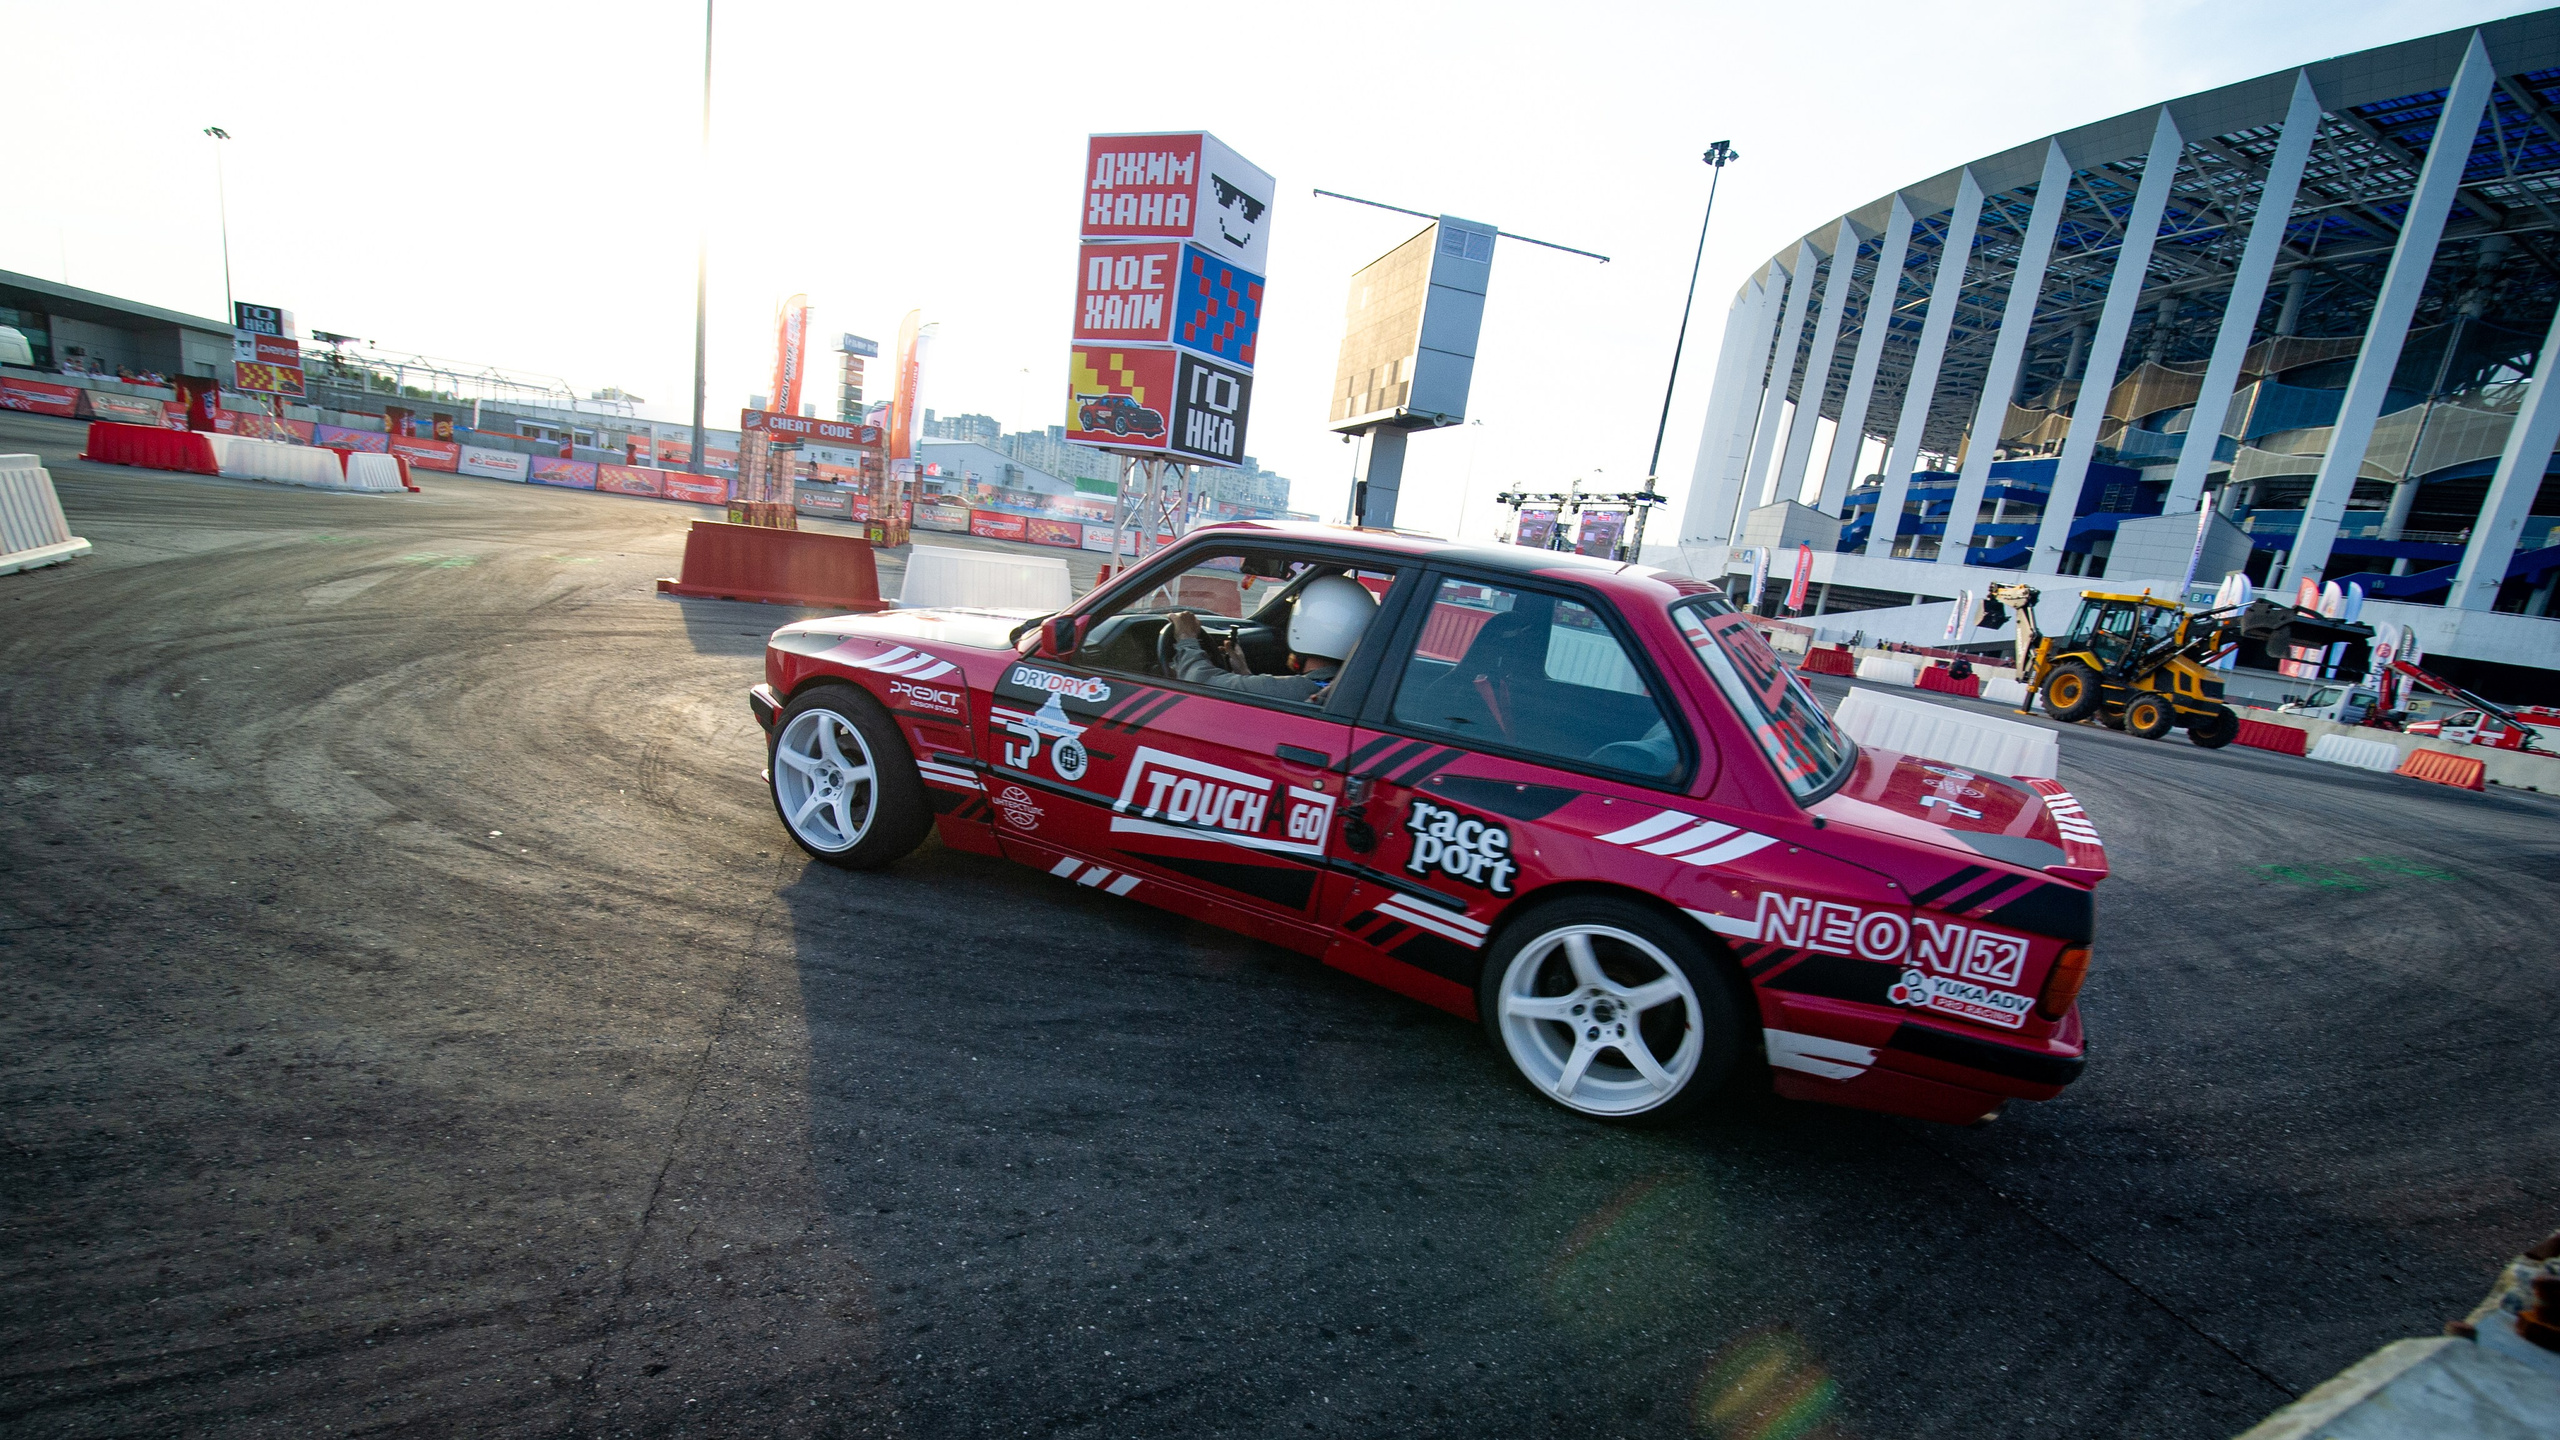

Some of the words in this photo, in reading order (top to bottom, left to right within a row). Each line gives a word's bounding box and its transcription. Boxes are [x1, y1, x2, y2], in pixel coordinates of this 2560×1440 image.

[1092, 151, 1195, 190] ДЖИМ
[1088, 193, 1190, 227] ХАНА
[1087, 254, 1168, 290] ПОЕ
[242, 304, 277, 321] ГО
[243, 317, 277, 334] НКА
[1083, 294, 1163, 329] ХАЛИ
[257, 343, 297, 358] DRIVE
[1190, 364, 1240, 415] ГО
[769, 417, 813, 434] CHEAT
[819, 424, 854, 440] CODE
[1185, 408, 1236, 457] НКА
[2193, 593, 2200, 602] B
[2204, 594, 2212, 603] A
[1011, 667, 1085, 696] DRYDRY
[910, 699, 933, 712] DESIGN
[935, 704, 959, 715] STUDIO
[1142, 771, 1268, 833] TOUCH
[1288, 803, 1325, 840] GO
[1407, 802, 1509, 859] race
[1407, 832, 1516, 892] port
[1756, 891, 1967, 974] NEON
[1971, 938, 2018, 979] 52
[1934, 976, 1987, 1004] YUKA
[1989, 988, 2034, 1012] ADV
[1937, 998, 1963, 1011] PRO
[1963, 1004, 2015, 1023] RACING
